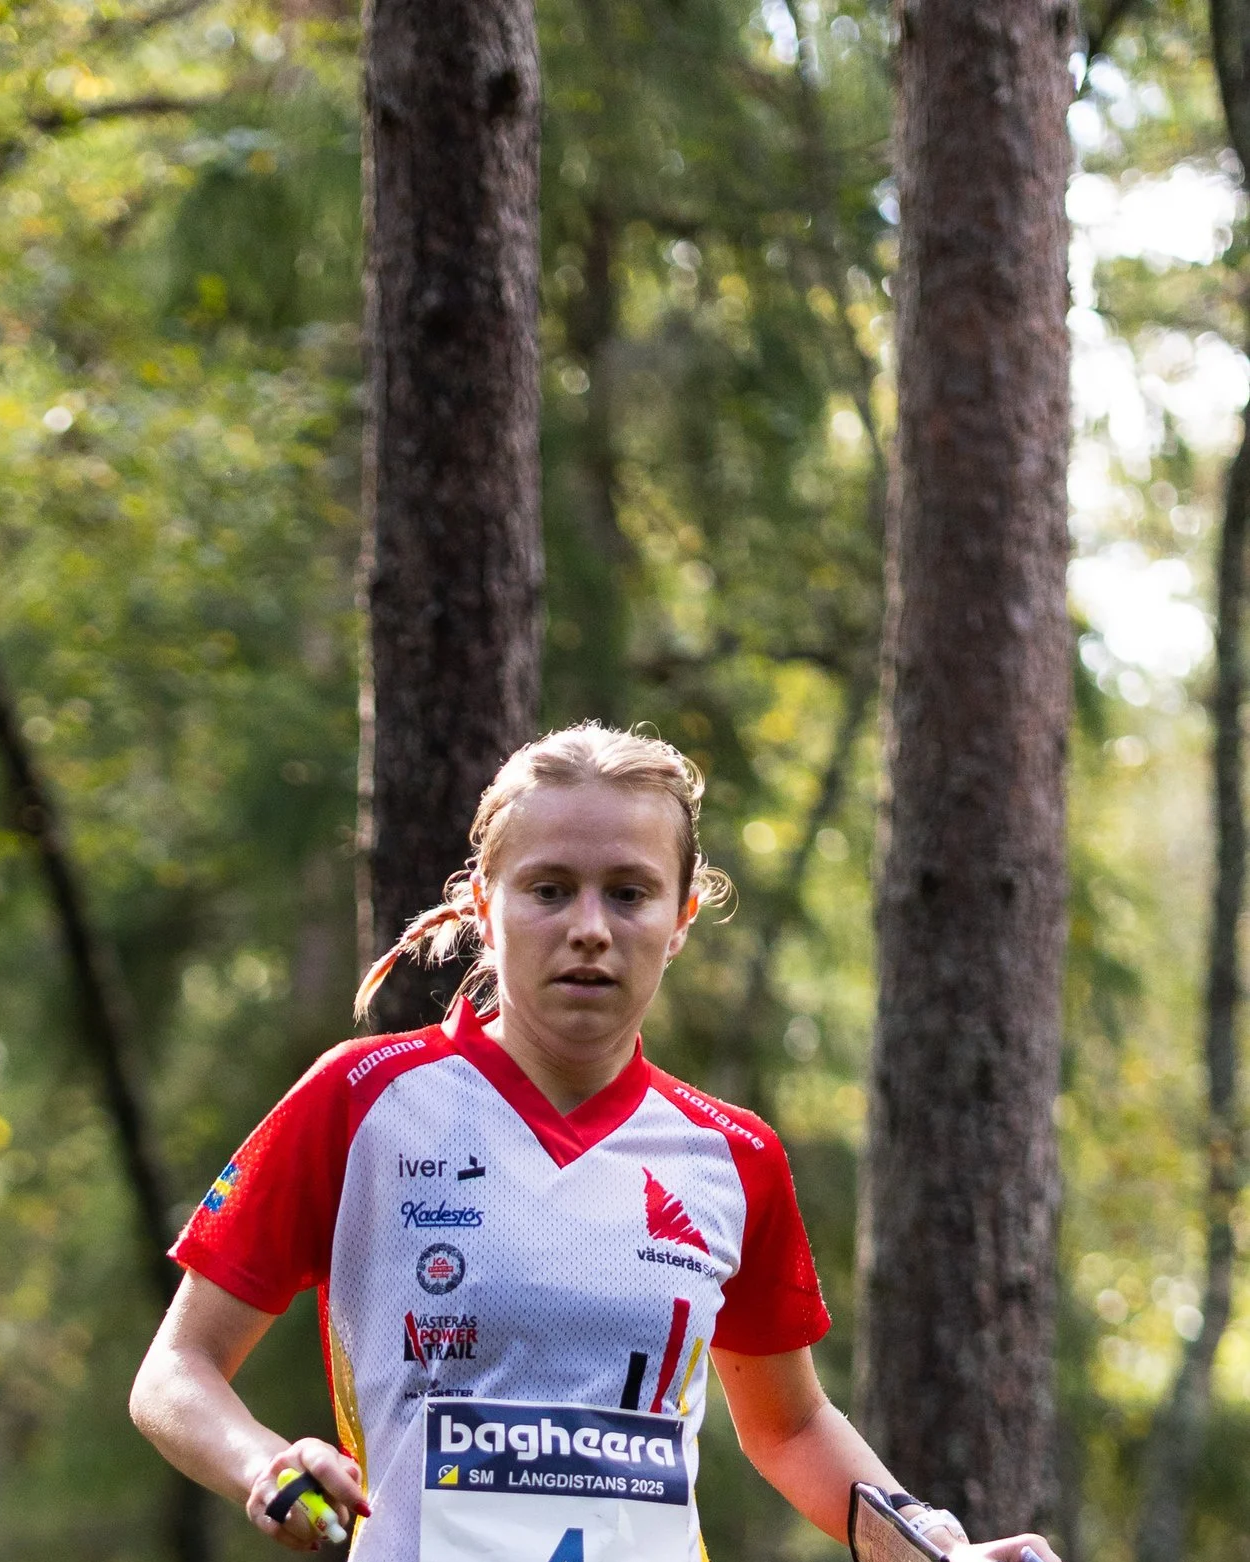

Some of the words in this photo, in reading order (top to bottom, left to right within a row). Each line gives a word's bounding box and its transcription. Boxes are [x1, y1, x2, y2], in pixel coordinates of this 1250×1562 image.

[346, 1039, 427, 1087] noname
[673, 1086, 765, 1150] noname
[398, 1152, 448, 1178] iver
[636, 1246, 702, 1273] västerås
[414, 1313, 478, 1328] VÄSTERÅS
[419, 1328, 479, 1344] POWER
[423, 1342, 477, 1360] TRAIL
[440, 1415, 677, 1467] bagheera
[468, 1469, 495, 1485] SM
[508, 1470, 628, 1491] LÅNGDISTANS
[631, 1479, 665, 1496] 2025
